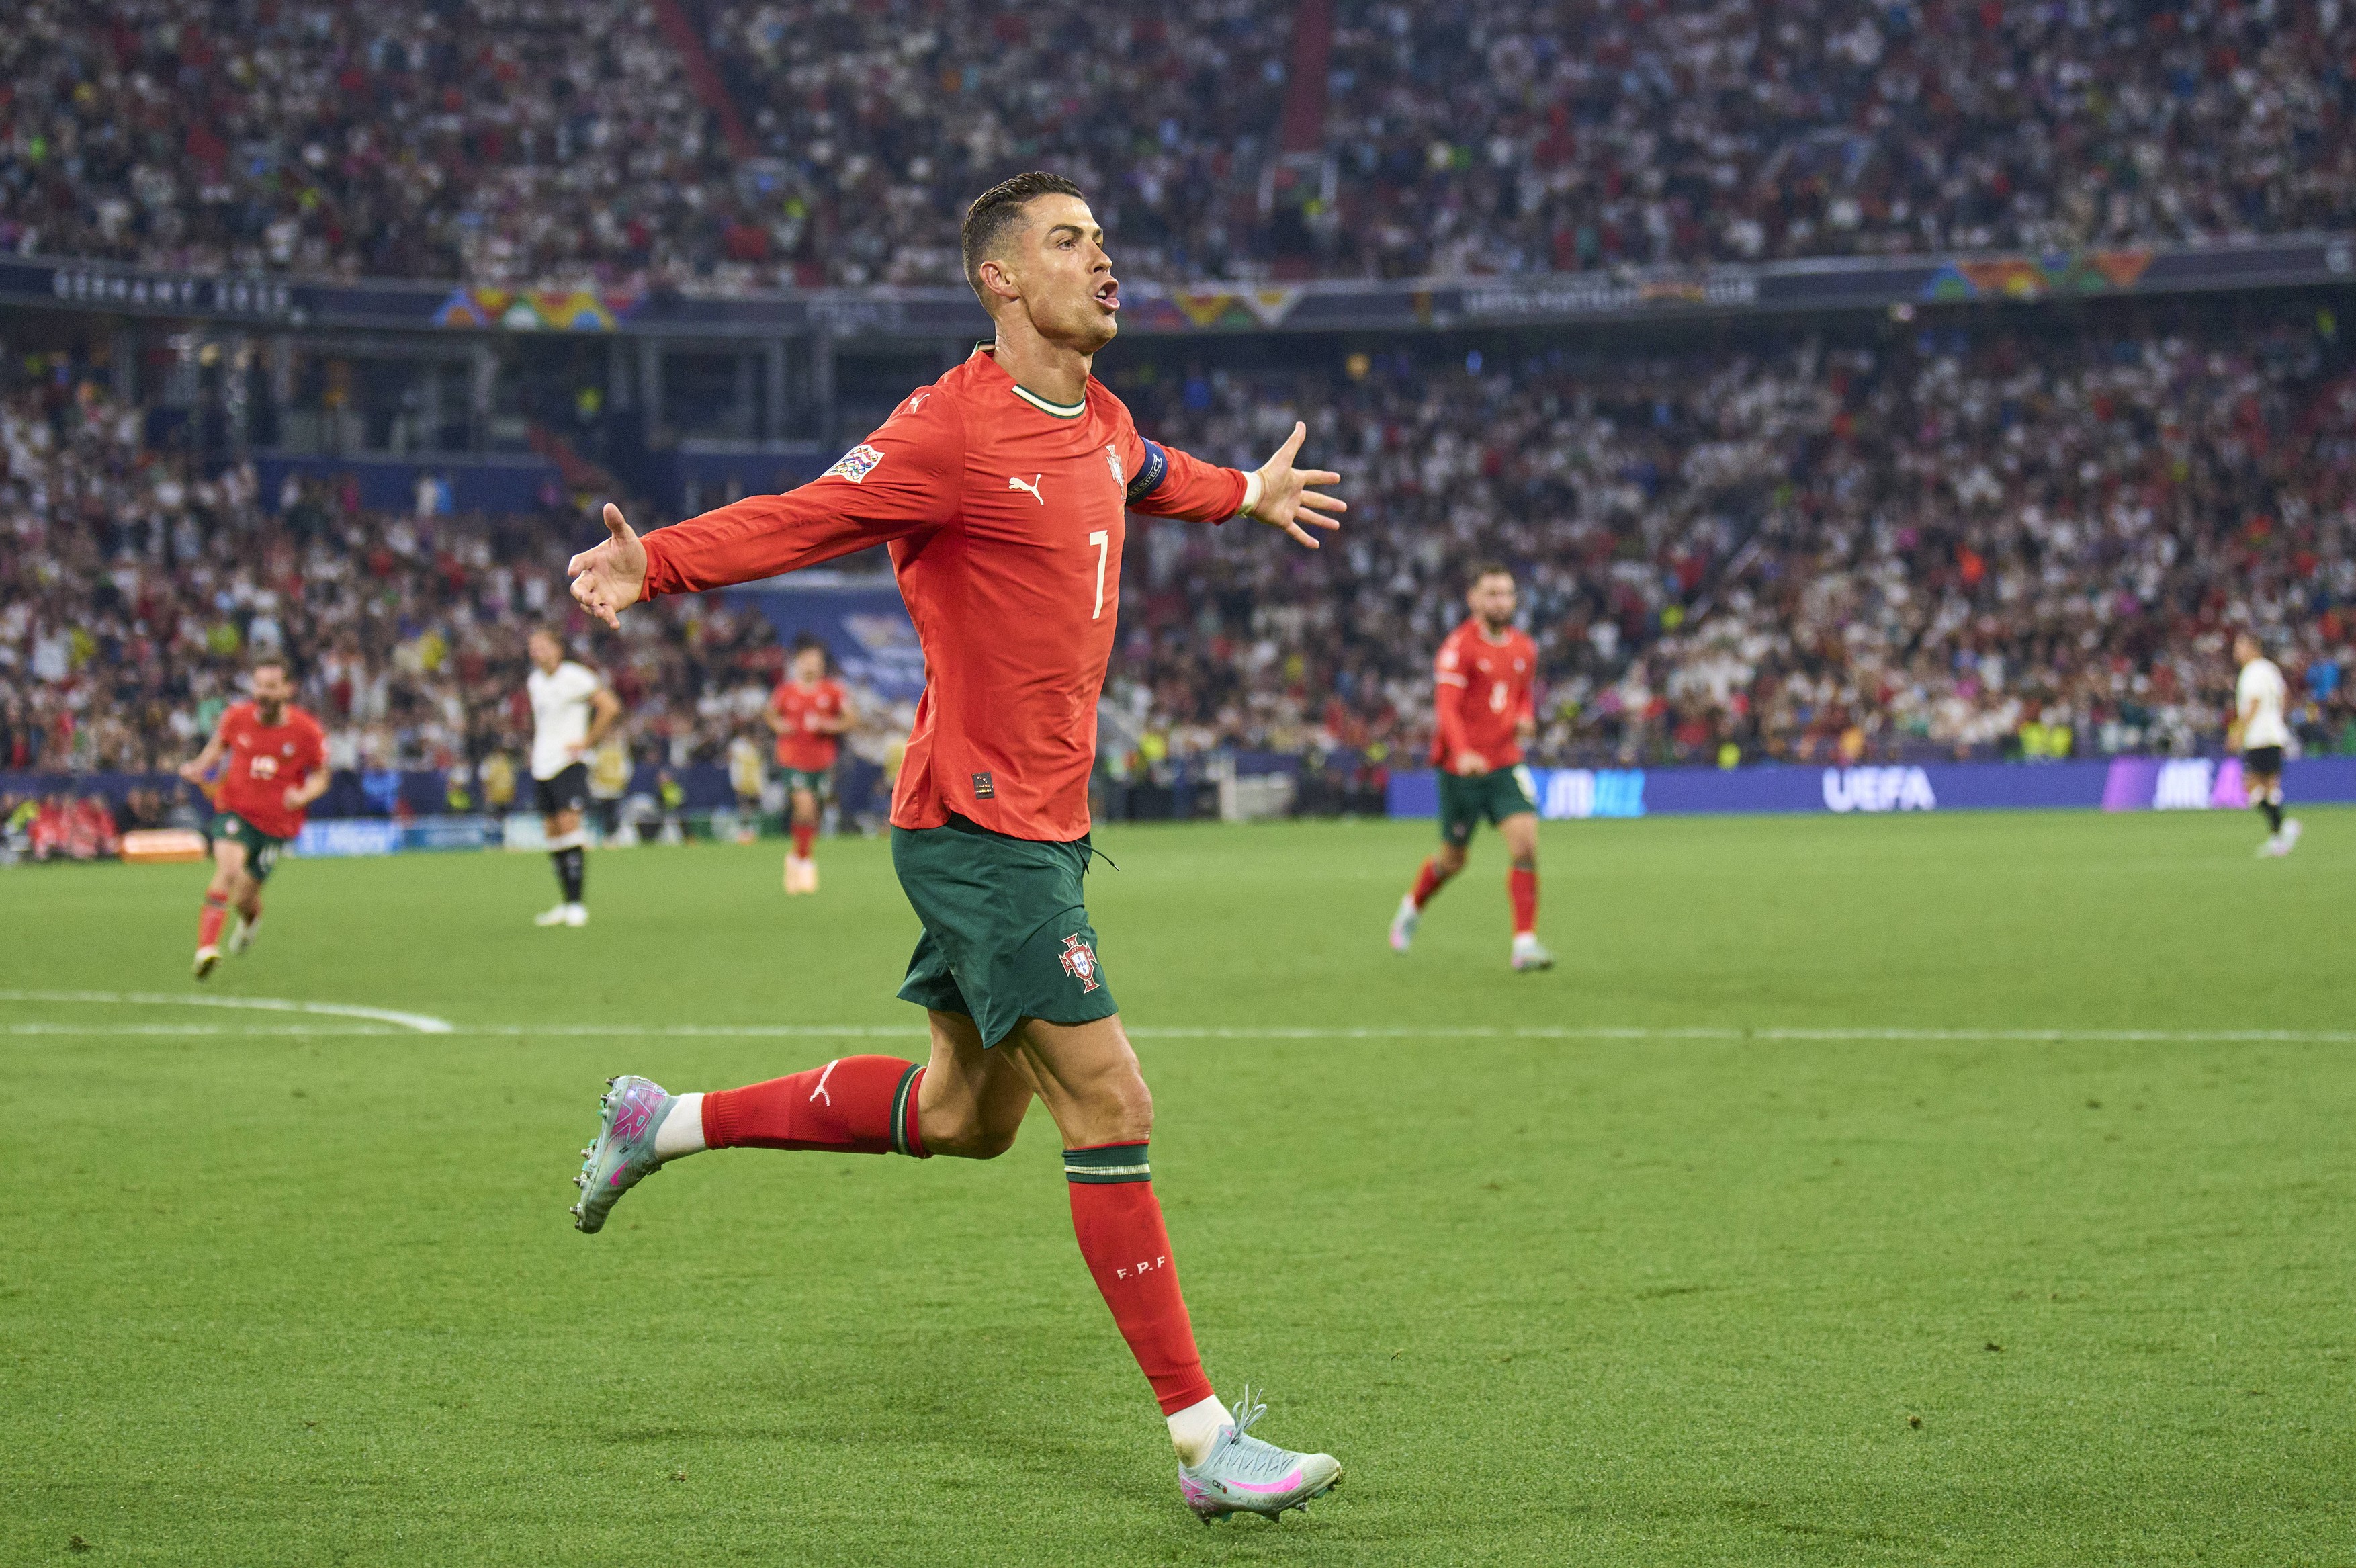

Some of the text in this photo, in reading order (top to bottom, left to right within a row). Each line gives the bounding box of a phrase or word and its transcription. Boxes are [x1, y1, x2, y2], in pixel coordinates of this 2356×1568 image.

[1128, 455, 1162, 497] RESPECT
[1089, 529, 1108, 619] 7
[1821, 765, 1937, 812] UEFA
